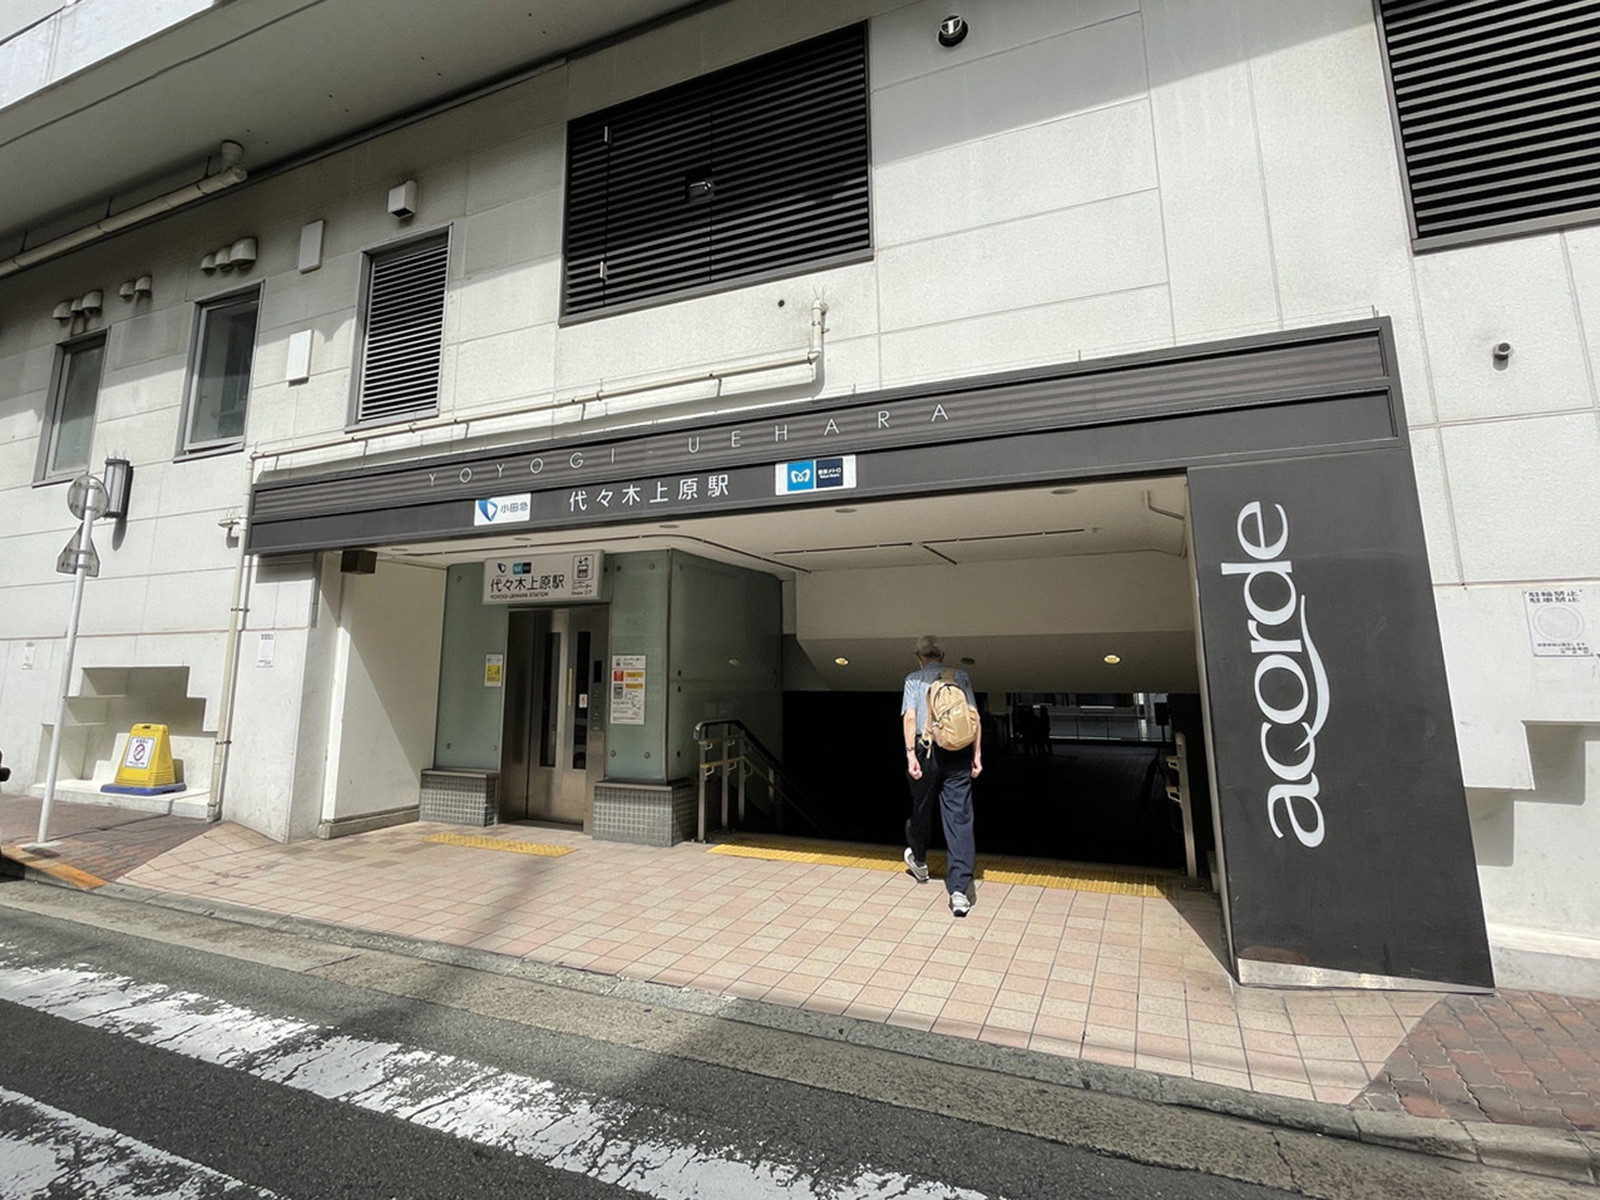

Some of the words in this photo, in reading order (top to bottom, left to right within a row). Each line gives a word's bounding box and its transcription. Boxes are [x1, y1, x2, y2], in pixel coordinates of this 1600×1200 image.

[569, 474, 729, 512] 代々木上原駅
[500, 502, 529, 513] 小田急
[490, 574, 565, 593] 代々木上原駅
[1220, 500, 1330, 849] acorde
